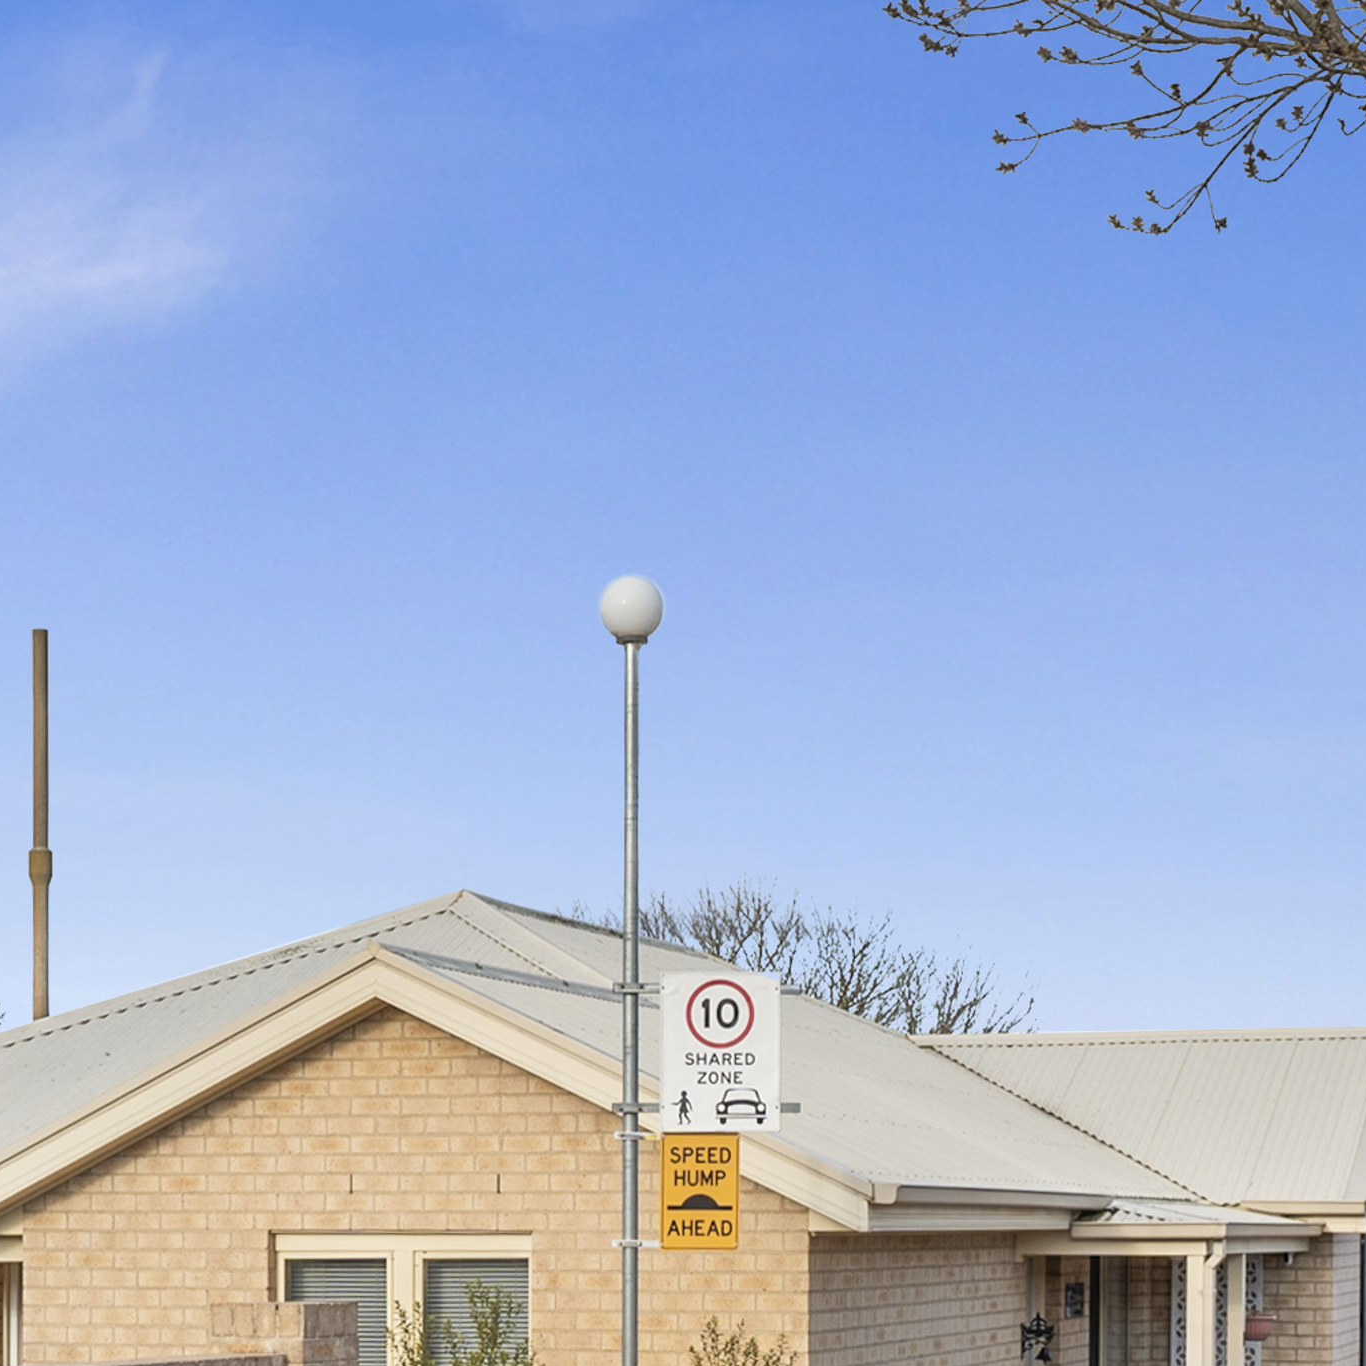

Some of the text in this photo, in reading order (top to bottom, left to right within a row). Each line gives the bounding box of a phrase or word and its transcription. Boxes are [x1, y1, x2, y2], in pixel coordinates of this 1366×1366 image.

[701, 998, 739, 1029] 10
[685, 1053, 756, 1066] SHARED
[697, 1071, 743, 1085] ZONE
[670, 1147, 732, 1164] SPEED
[674, 1170, 726, 1187] HUMP
[667, 1220, 733, 1237] AHEAD
